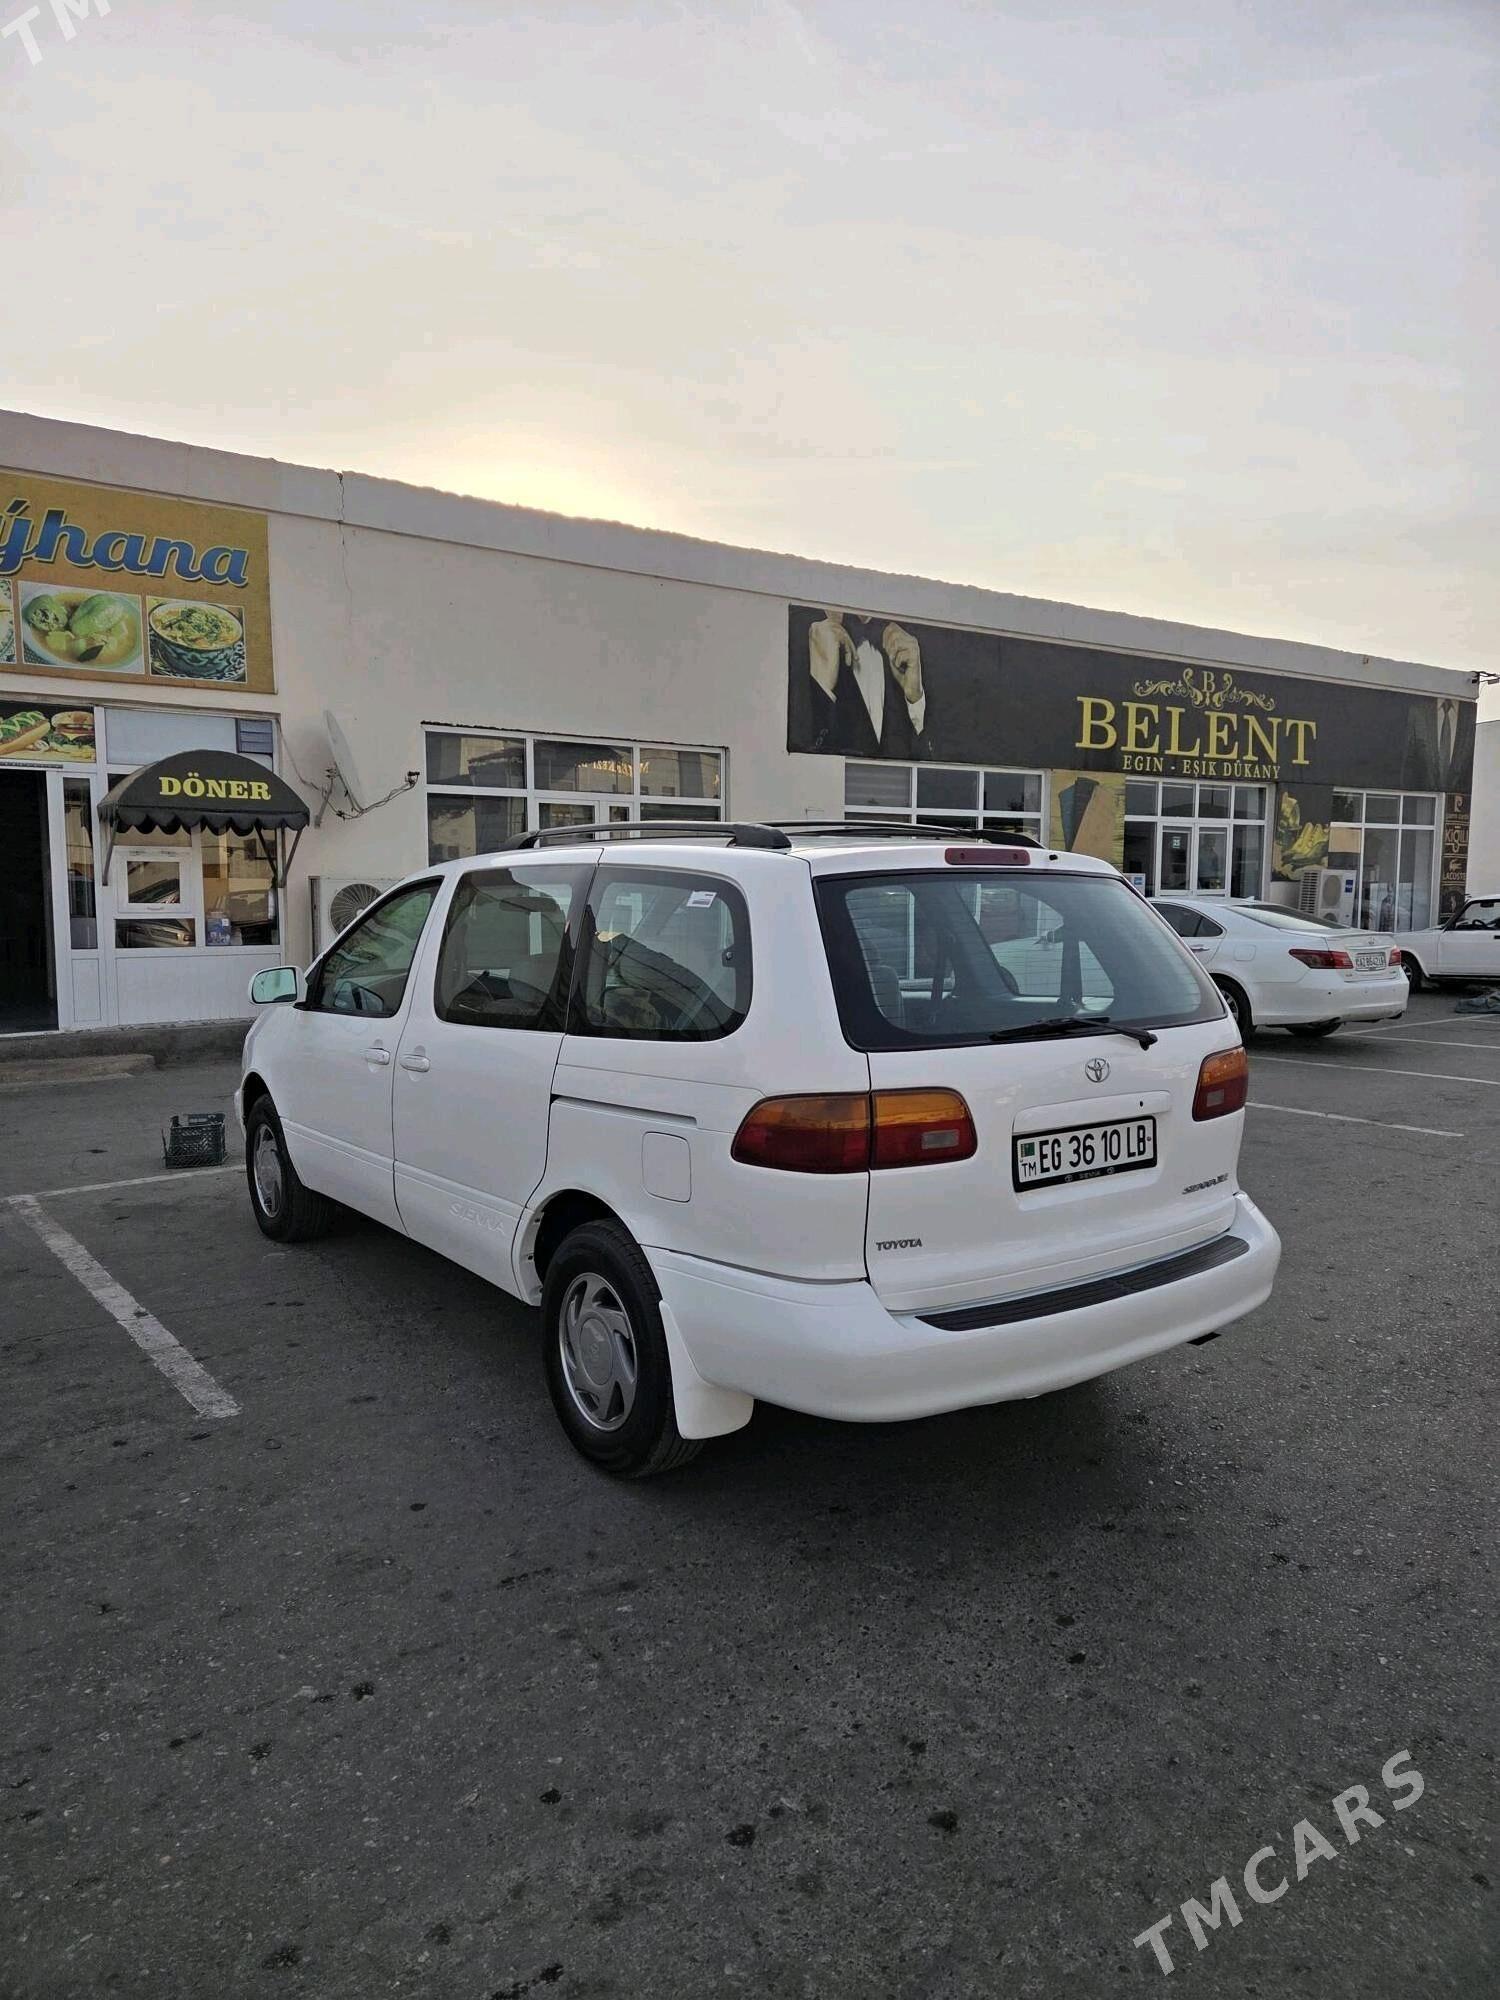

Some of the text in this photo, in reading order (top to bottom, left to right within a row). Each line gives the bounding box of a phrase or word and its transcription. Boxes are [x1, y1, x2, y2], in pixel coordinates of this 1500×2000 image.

[1202, 671, 1216, 693] B
[1074, 696, 1317, 765] BELENT
[1122, 755, 1164, 772] EGIN
[1182, 759, 1217, 777] EŞIK
[1223, 760, 1281, 779] DÜKANY
[159, 772, 272, 801] DÖNER
[1039, 1125, 1146, 1174] EG 36 10 LB
[1021, 1161, 1037, 1178] TM
[876, 1238, 923, 1251] TOYOTA
